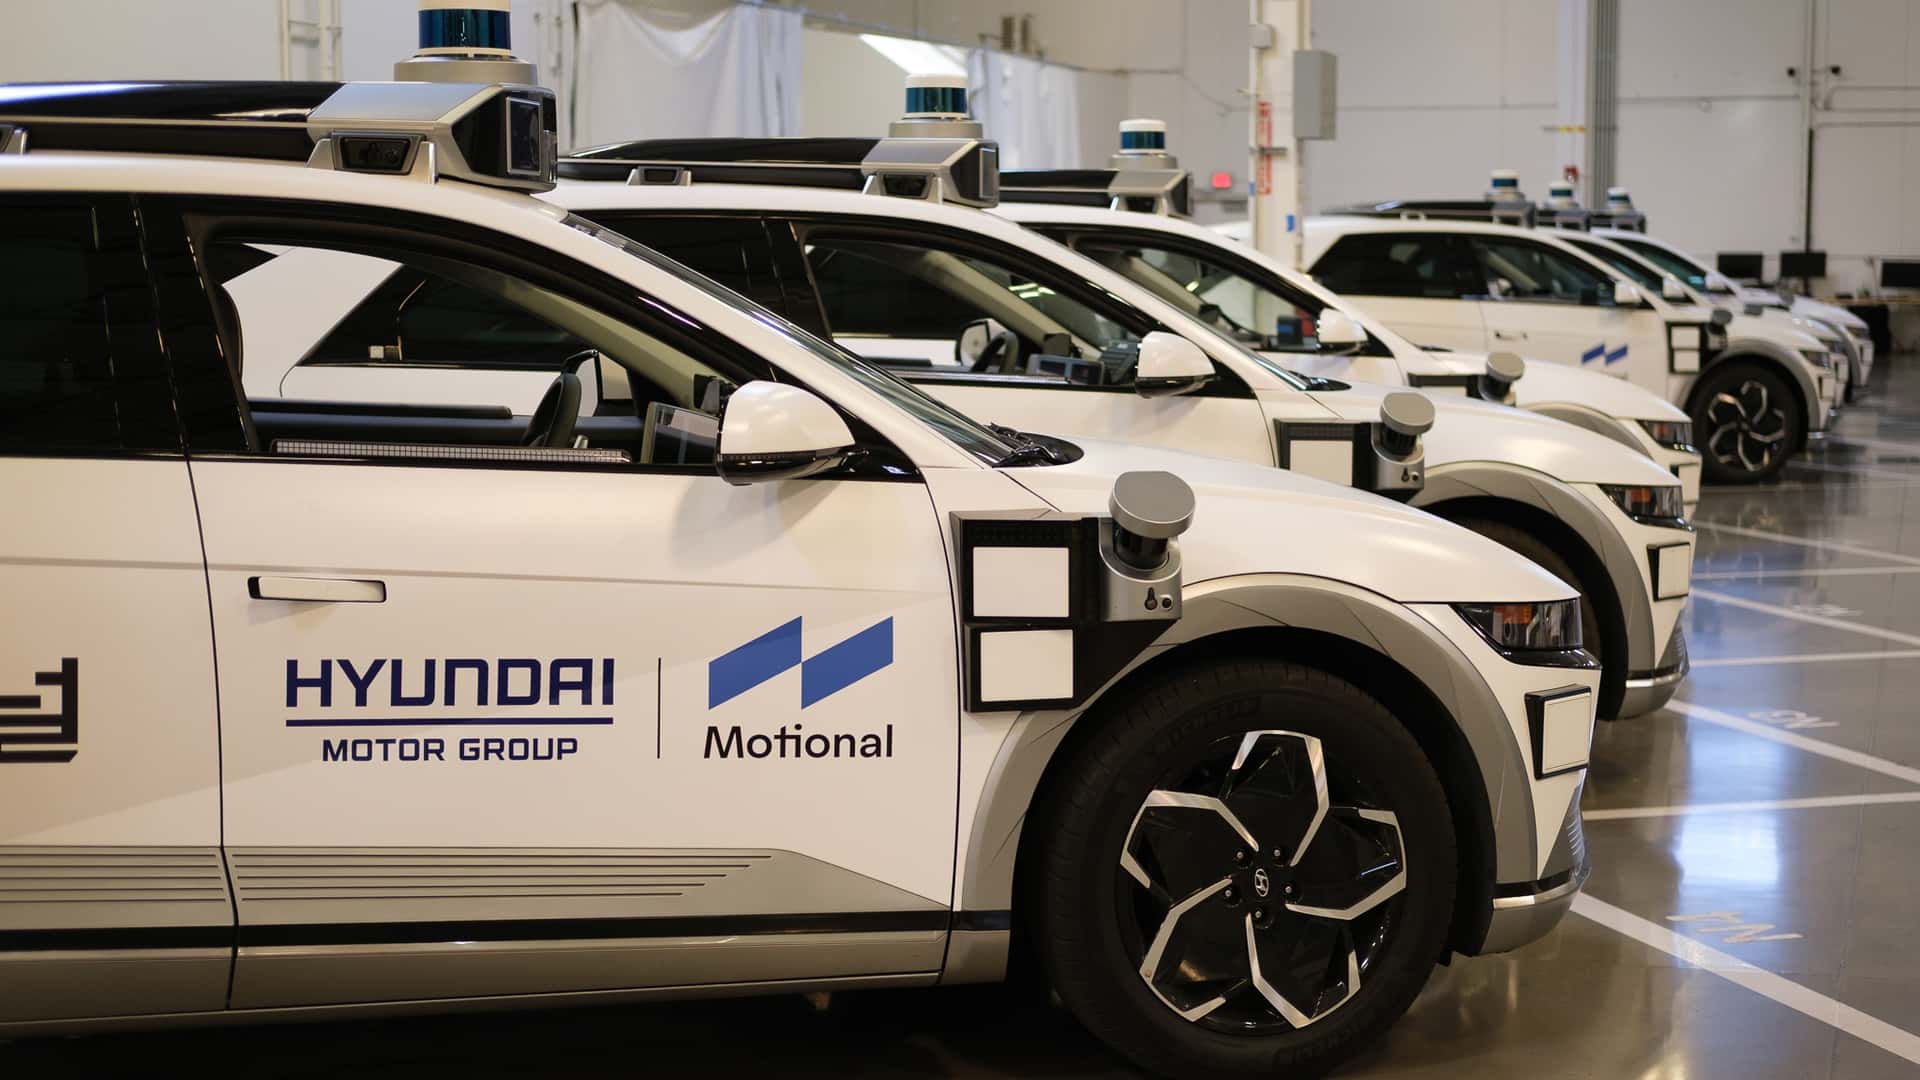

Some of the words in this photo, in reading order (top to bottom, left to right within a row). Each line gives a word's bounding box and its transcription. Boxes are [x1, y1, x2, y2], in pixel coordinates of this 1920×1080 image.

[286, 658, 615, 708] HYUNDAI
[323, 738, 445, 762] MOTOR
[459, 737, 578, 762] GROUP
[704, 723, 893, 759] Motional
